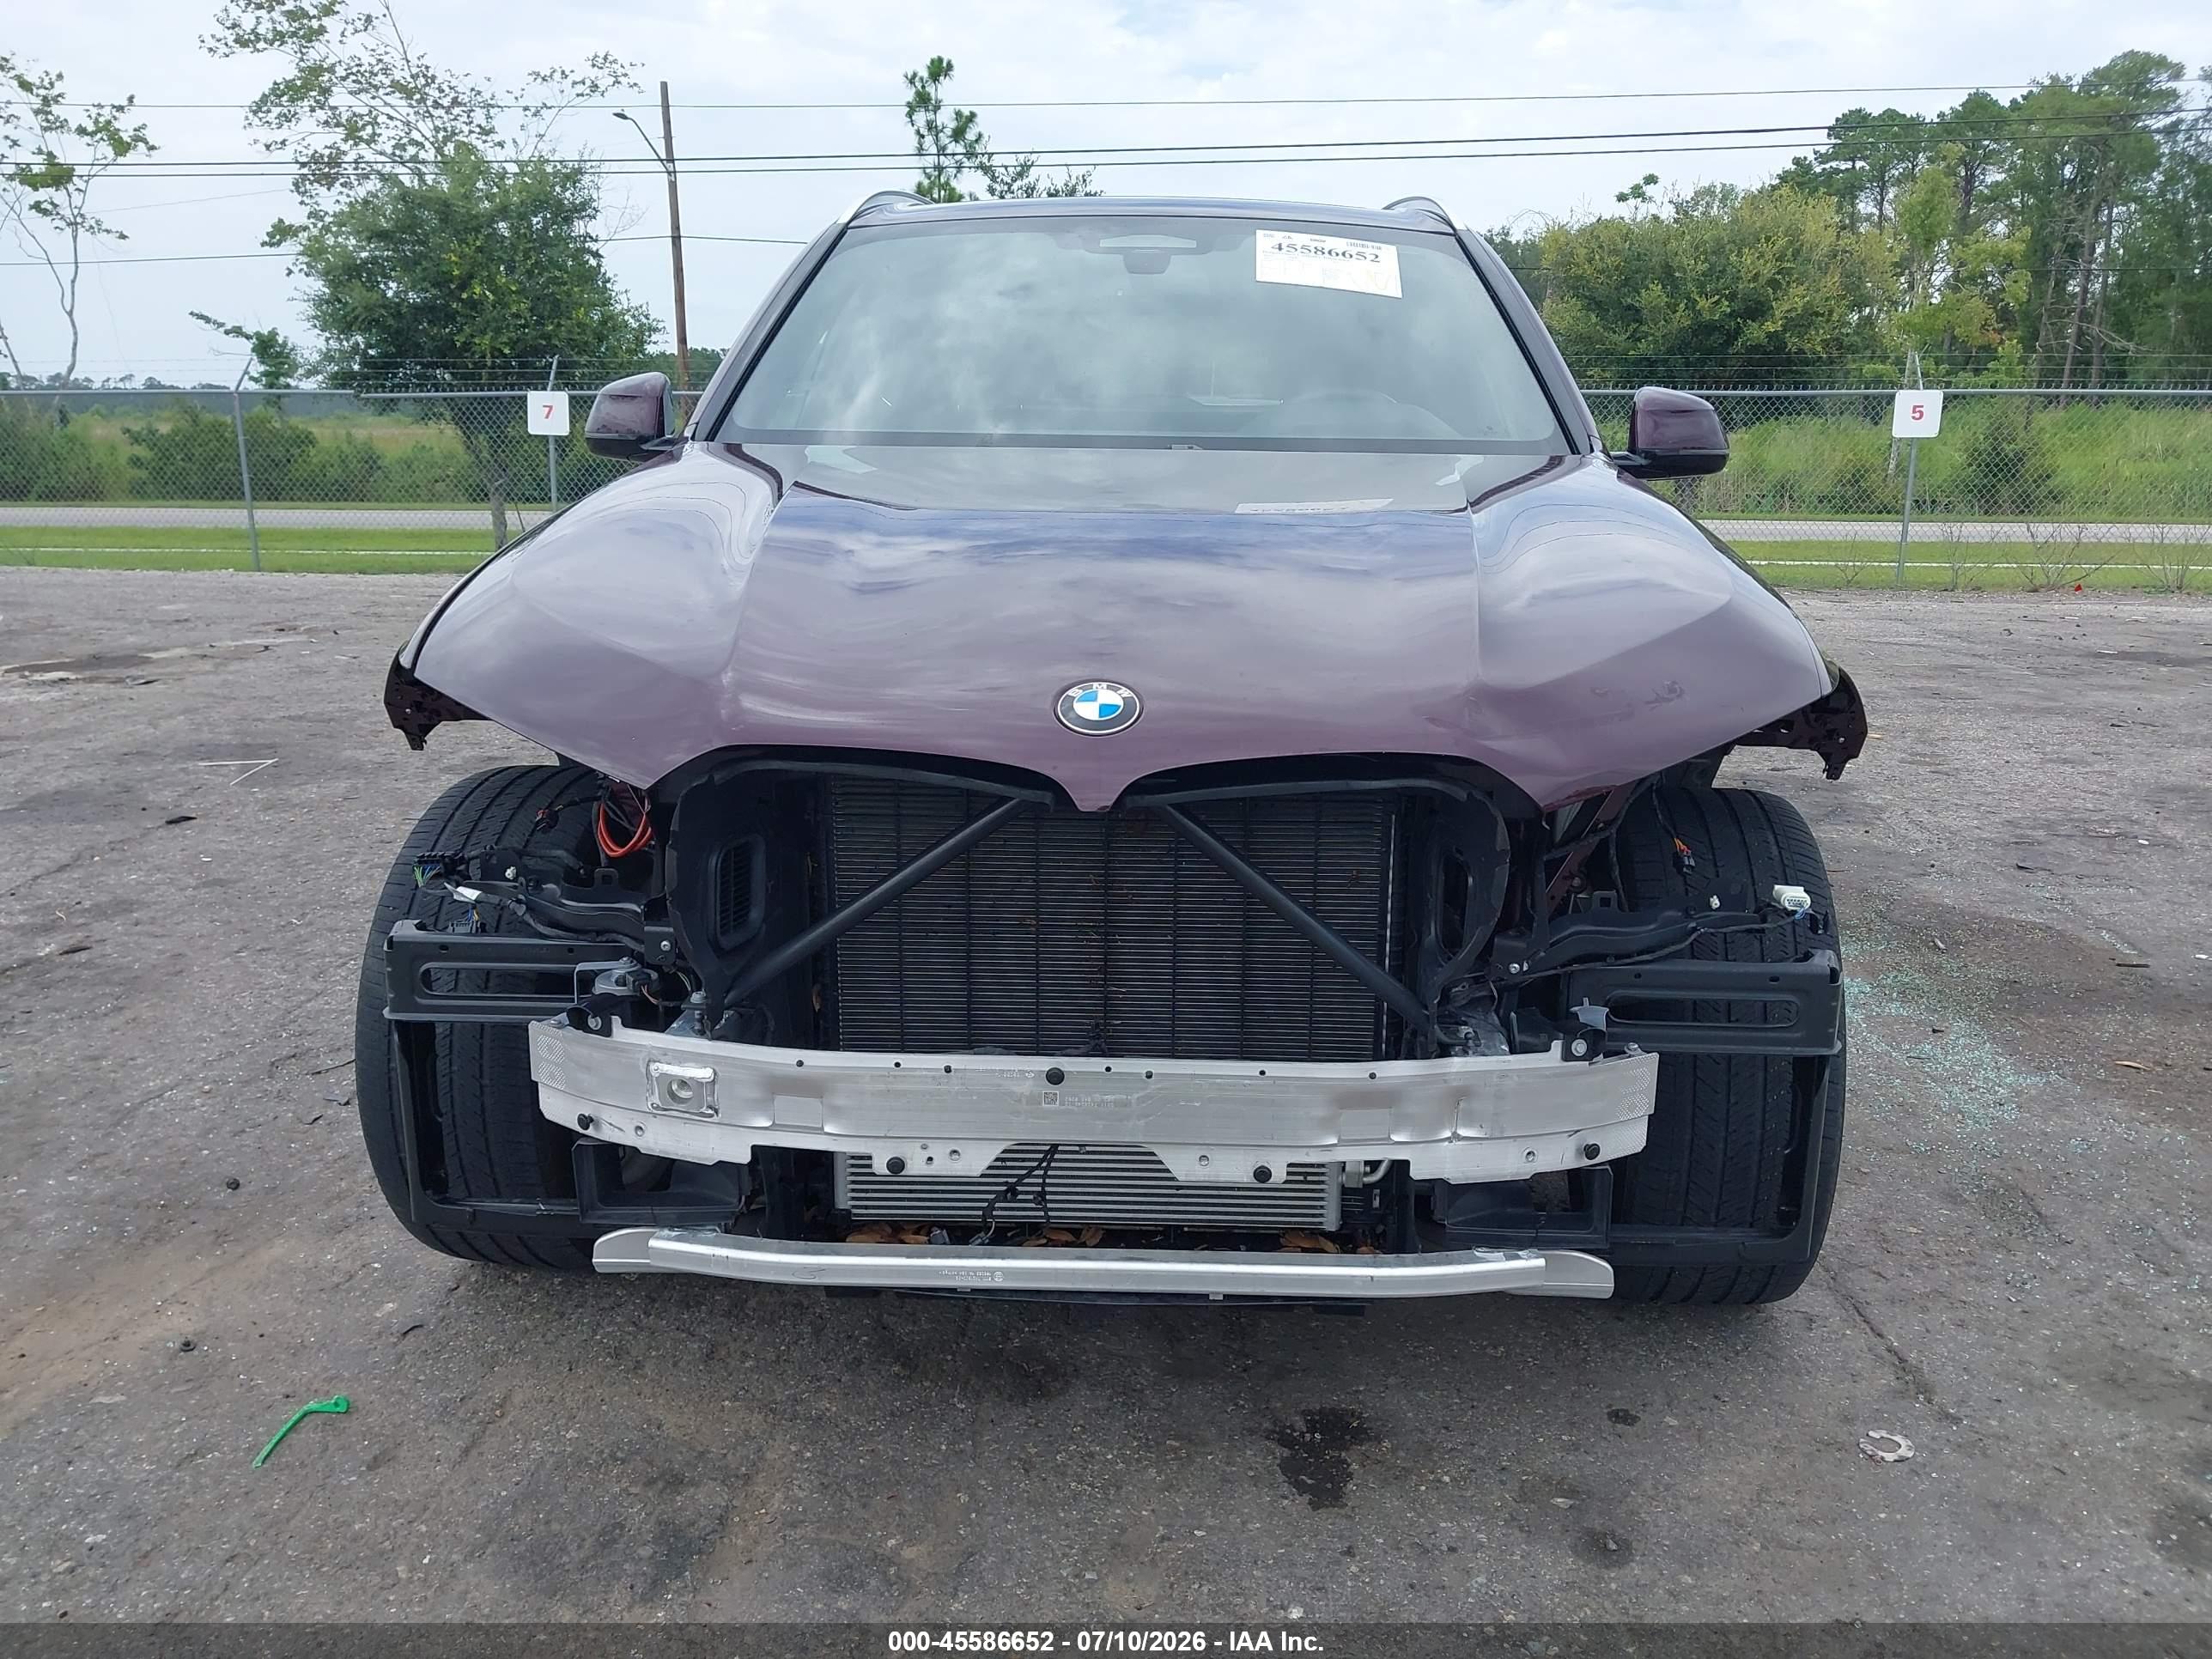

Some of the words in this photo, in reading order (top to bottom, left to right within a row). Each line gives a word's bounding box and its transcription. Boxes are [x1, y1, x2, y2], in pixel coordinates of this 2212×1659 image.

[1271, 242, 1381, 264] 45586652
[543, 404, 554, 420] 7
[1911, 404, 1924, 421] 5
[1067, 683, 1134, 697] BMW
